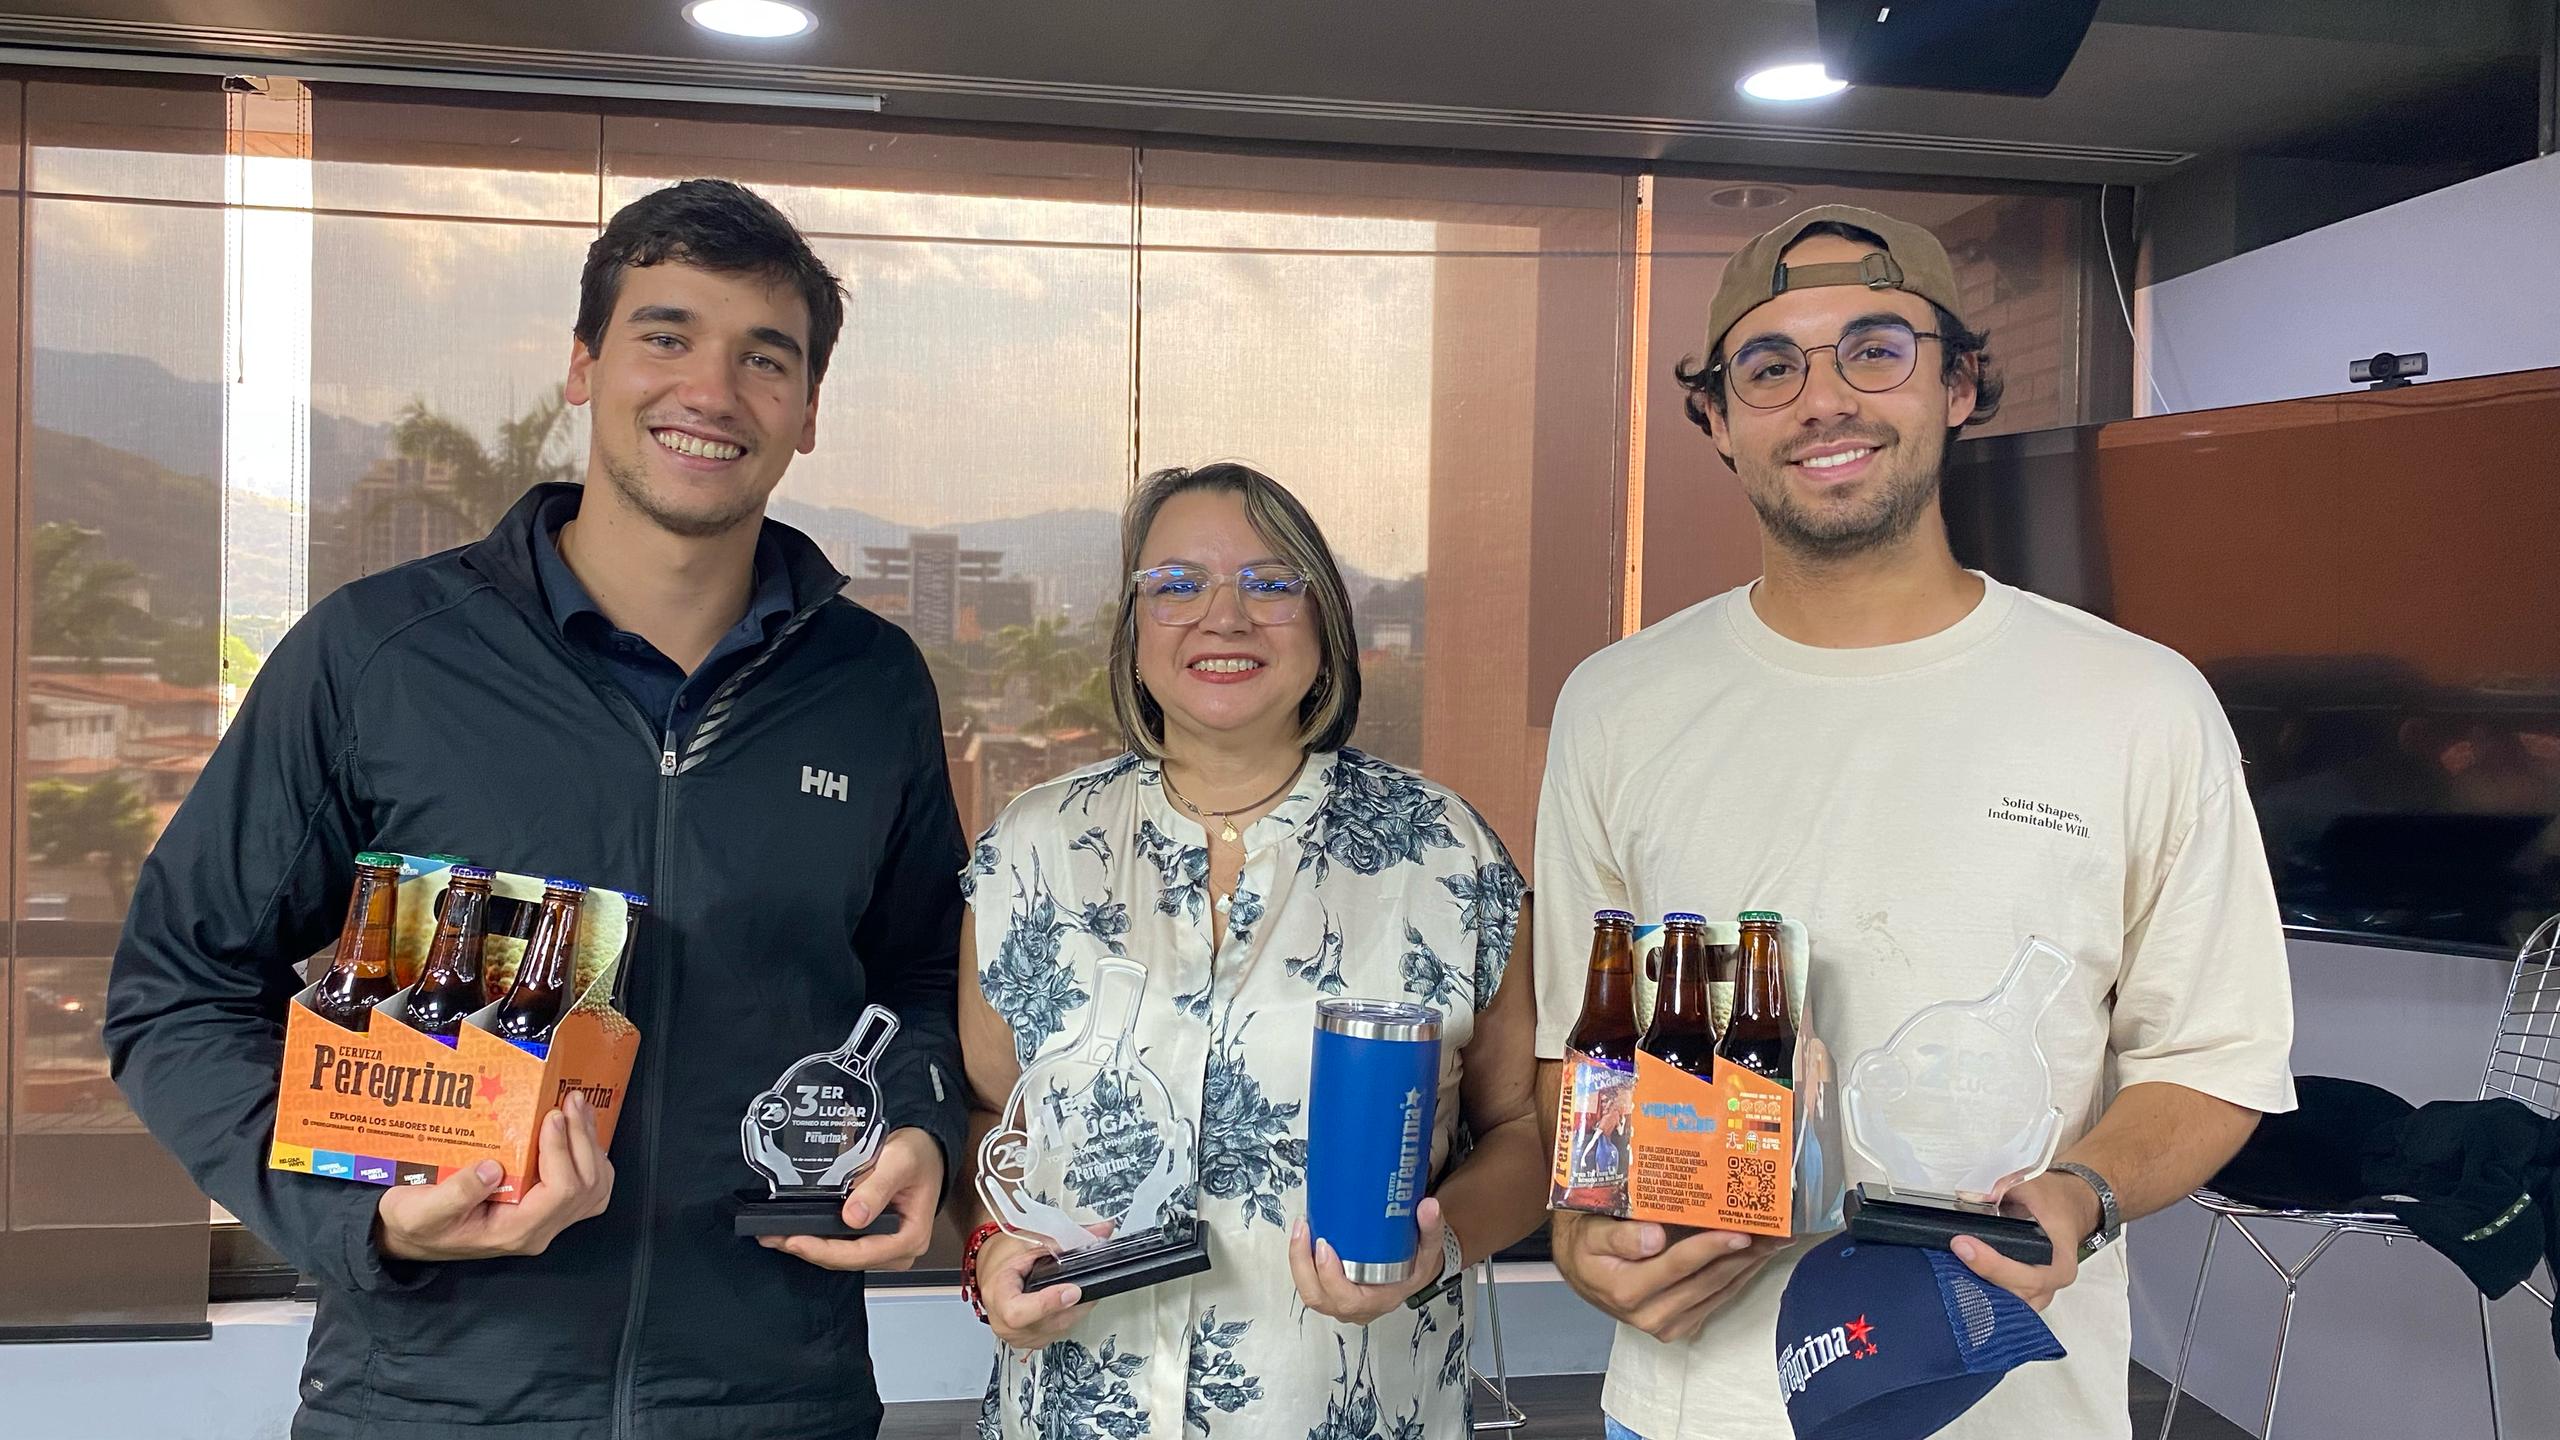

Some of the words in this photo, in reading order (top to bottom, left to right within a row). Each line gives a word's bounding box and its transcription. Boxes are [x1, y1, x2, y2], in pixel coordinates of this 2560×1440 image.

[801, 766, 848, 802] HH
[2002, 797, 2033, 811] Solid
[2037, 803, 2082, 823] Shapes,
[1988, 808, 2063, 831] Indomitable
[2066, 822, 2090, 838] Will.
[339, 1046, 382, 1060] CERVEZA
[310, 1044, 475, 1110] Peregrina
[793, 1085, 819, 1117] 3
[821, 1086, 844, 1099] ER
[819, 1106, 866, 1117] LUGAR
[330, 1112, 367, 1123] EXPLORA
[370, 1117, 386, 1126] LOS
[389, 1119, 427, 1131] SABORES
[429, 1124, 440, 1133] DE
[442, 1126, 453, 1134] LA
[455, 1128, 475, 1137] VIDA
[1104, 1134, 1129, 1150] PING
[1655, 1146, 1673, 1155] CERVEZA
[1674, 1149, 1700, 1157] ELABORADA
[1385, 1108, 1422, 1218] Peregrina
[1648, 1154, 1665, 1162] CEBADA
[1666, 1156, 1688, 1164] MALTEADA
[1645, 1162, 1664, 1170] ACUERDO
[1669, 1165, 1698, 1174] TRADICIONES
[1663, 1172, 1687, 1181] CRISTALINA
[1387, 1171, 1397, 1201] CERVEZA
[1673, 1181, 1687, 1189] LAGER
[1637, 1185, 1655, 1193] CERVEZA
[1657, 1187, 1684, 1196] SOFISTICADA
[1689, 1192, 1712, 1200] PODEROSA
[1650, 1202, 1665, 1210] MUCHO
[1691, 1199, 1705, 1207] DULCE
[1718, 1210, 1744, 1218] ESCANEA
[1743, 1220, 1780, 1229] EXPERIENCIA
